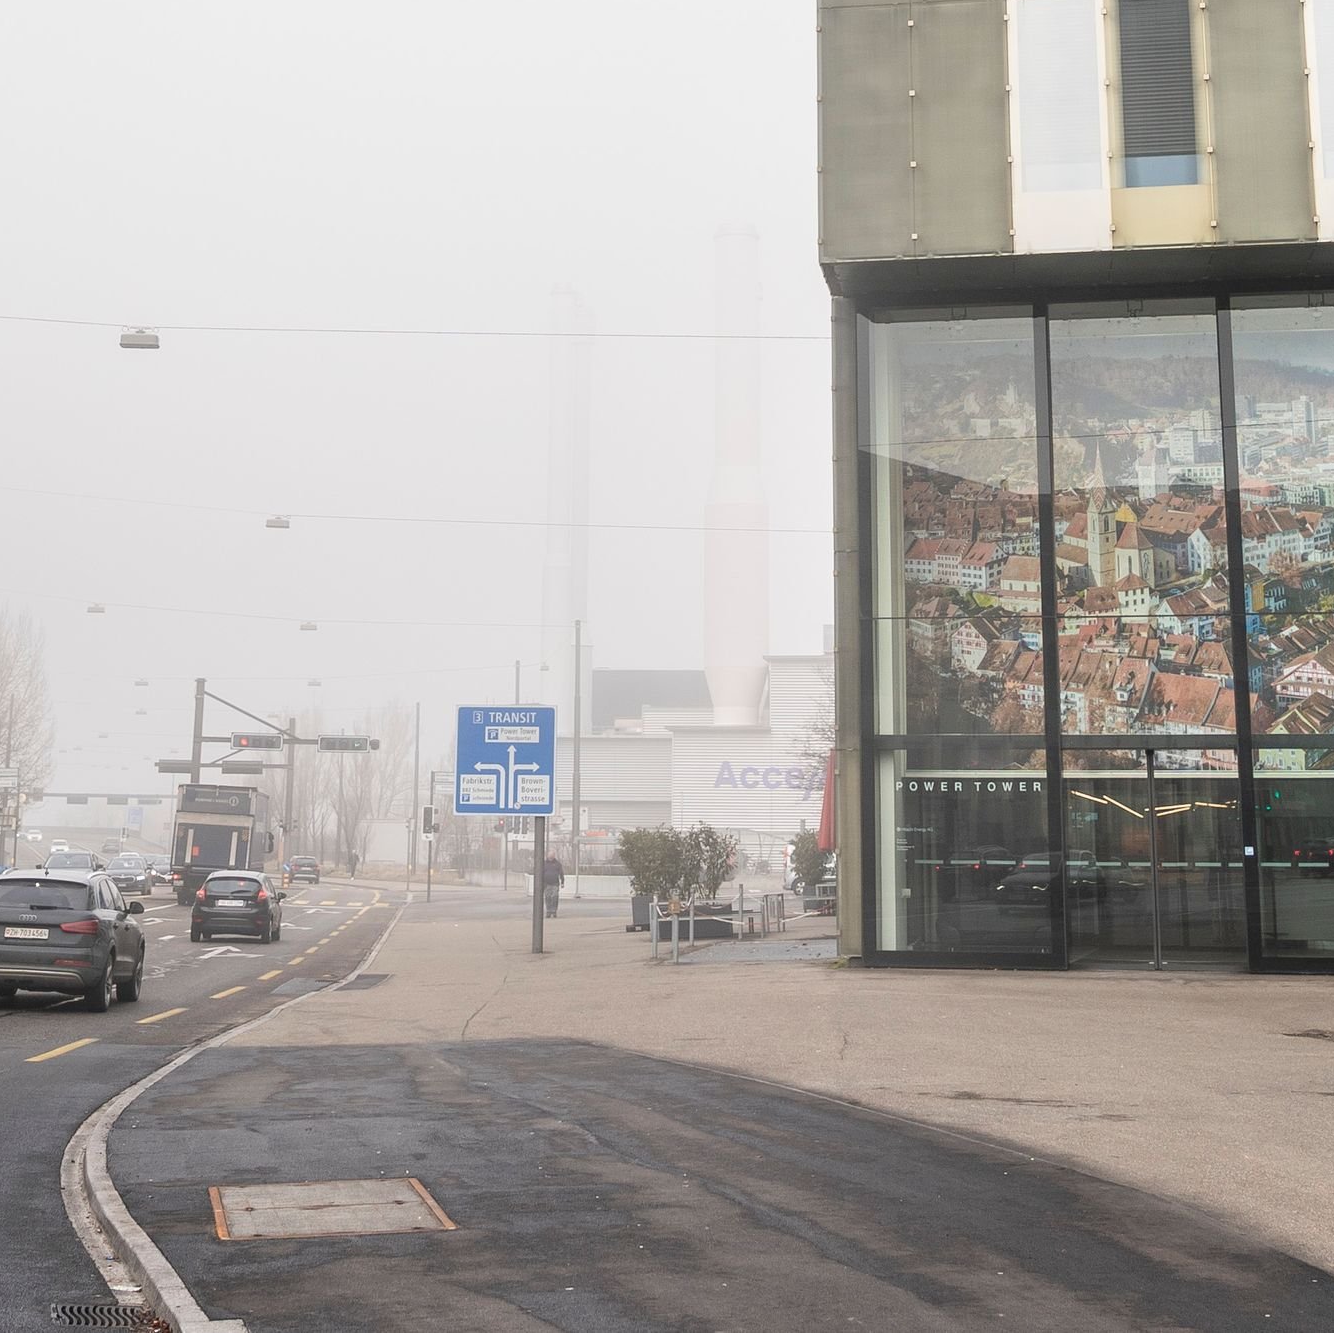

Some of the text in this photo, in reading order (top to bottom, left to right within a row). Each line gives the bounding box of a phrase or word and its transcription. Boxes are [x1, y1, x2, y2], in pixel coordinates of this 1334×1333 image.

[489, 712, 537, 723] TRANSIT
[462, 777, 495, 785] Fabrikstr.
[896, 781, 1042, 792] POWER TOWER
